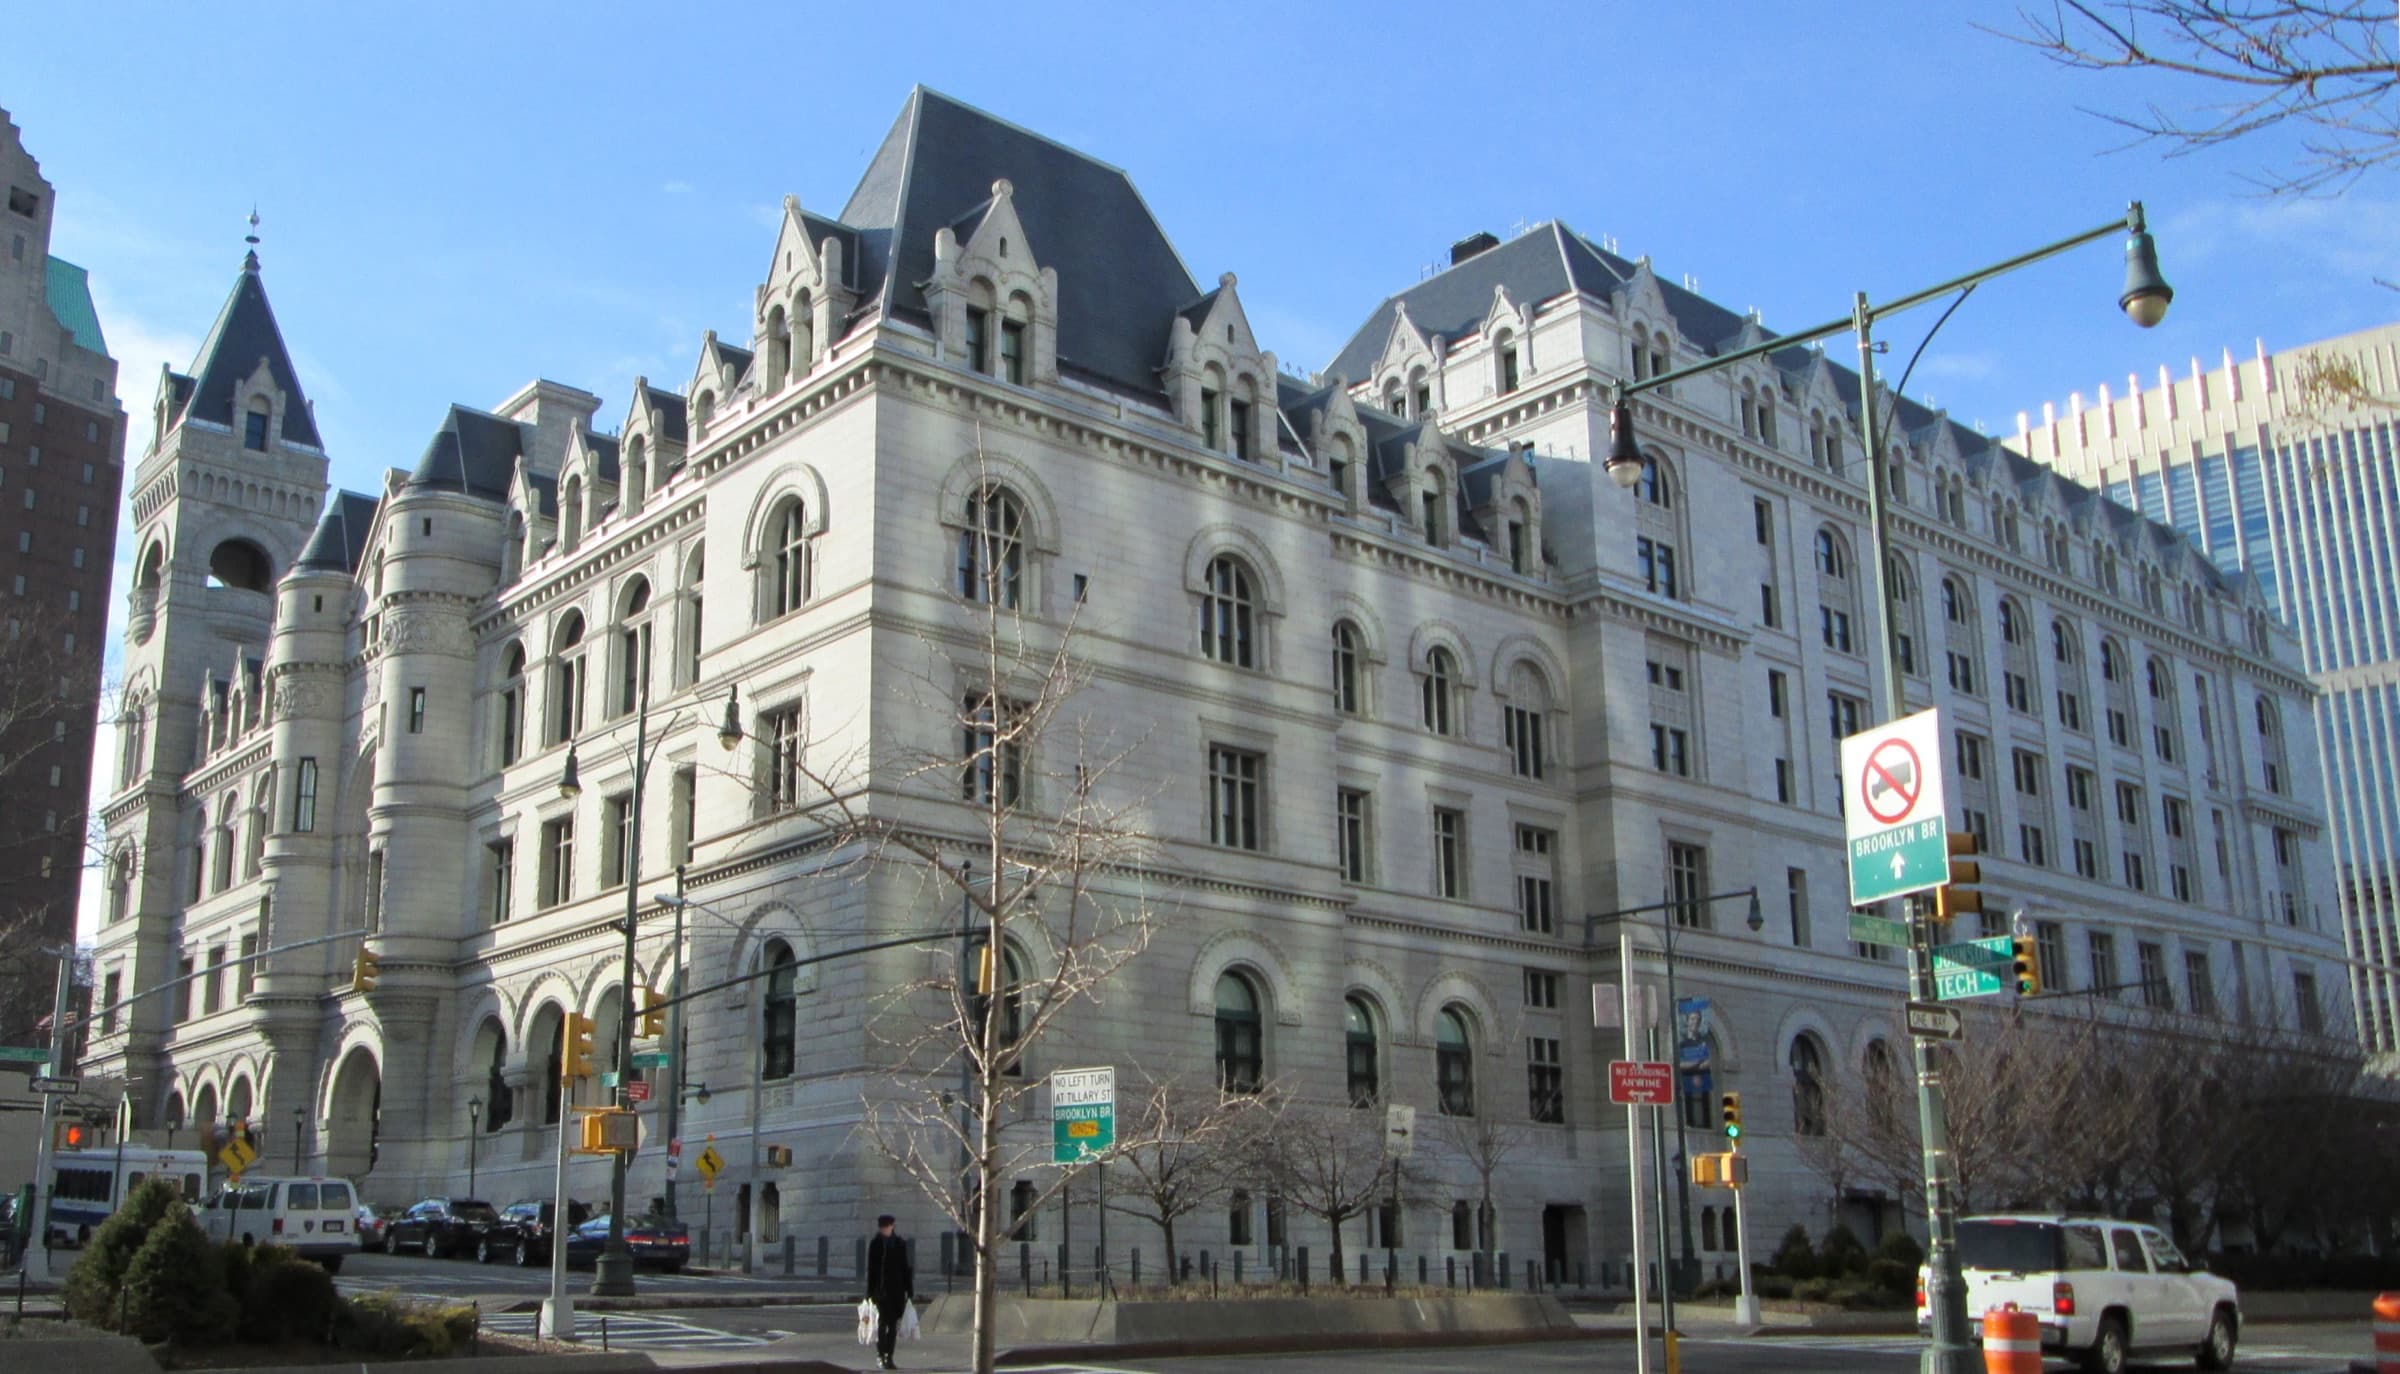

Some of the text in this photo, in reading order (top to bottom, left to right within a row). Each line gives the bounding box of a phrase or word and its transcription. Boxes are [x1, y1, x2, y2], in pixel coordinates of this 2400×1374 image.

[1856, 820, 1938, 857] BROOKLYN BR
[1937, 942, 1991, 968] JOHNSON
[1936, 972, 1978, 998] TECH
[1056, 1074, 1110, 1088] NO LEFT TURN
[1621, 1078, 1661, 1089] ANYTIME
[1056, 1089, 1111, 1103] AT TILLARY ST
[1055, 1106, 1111, 1121] BROOKLYN BR
